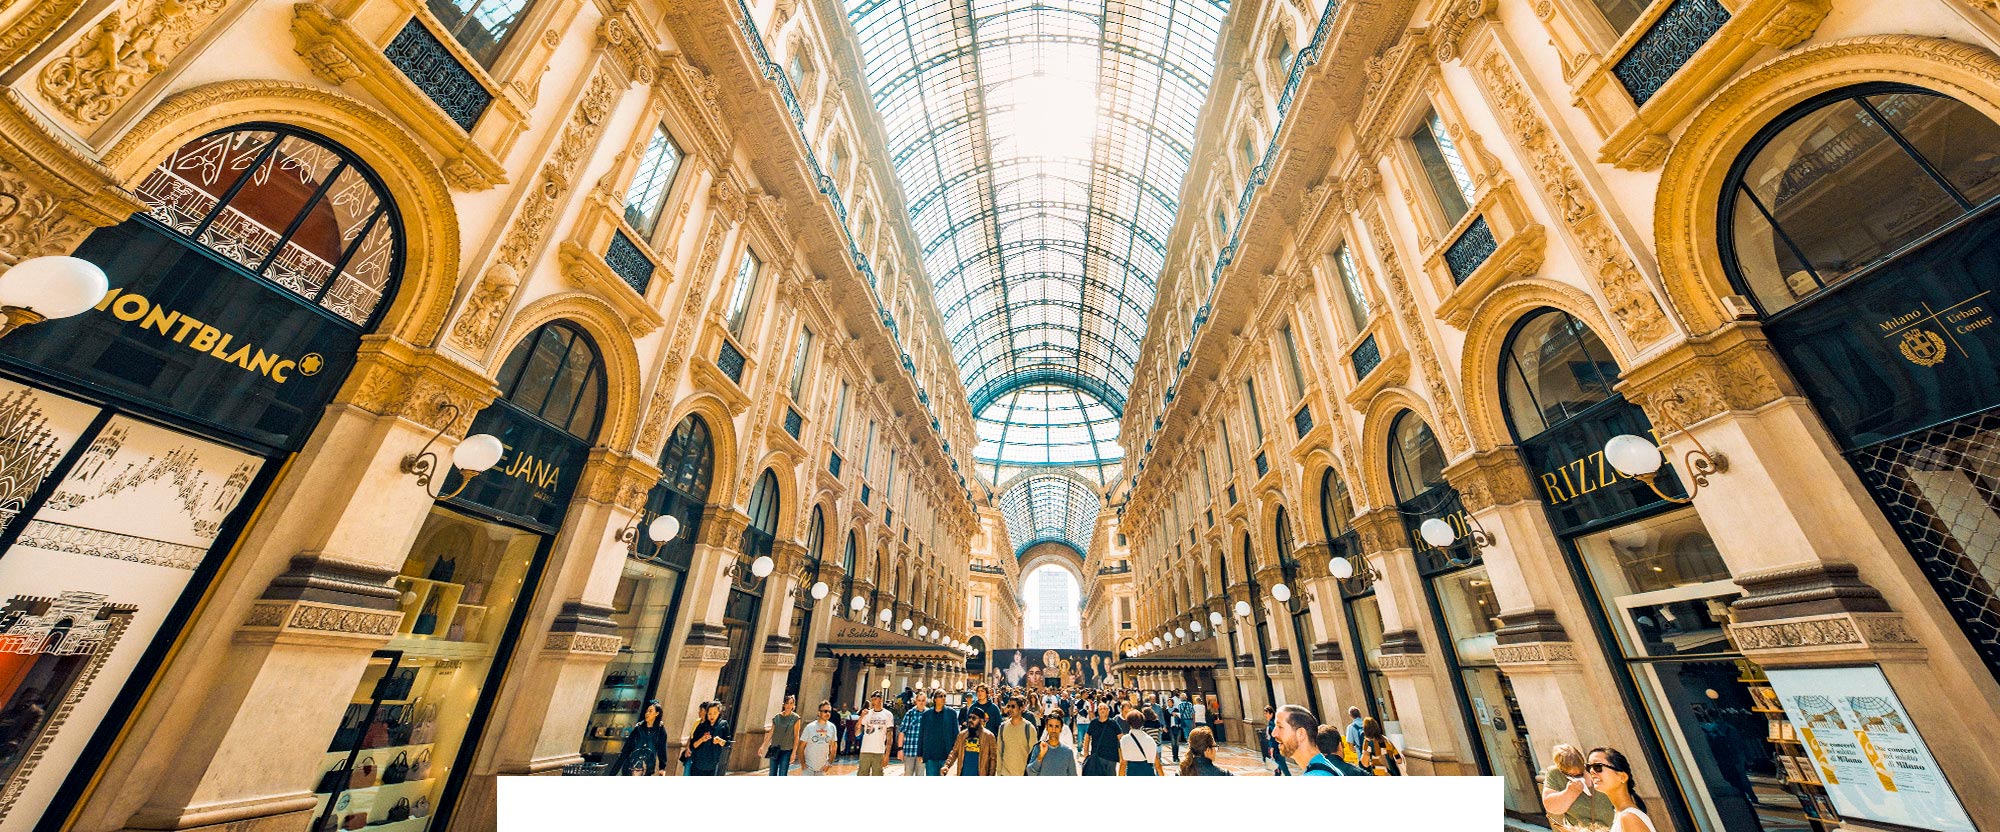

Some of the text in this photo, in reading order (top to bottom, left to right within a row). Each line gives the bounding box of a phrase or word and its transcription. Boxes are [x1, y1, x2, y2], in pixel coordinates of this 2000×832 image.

[1879, 309, 1922, 332] Milano
[1946, 306, 1983, 324] Urban
[1956, 316, 1994, 335] Center
[491, 442, 560, 493] EJANA
[1540, 428, 1672, 505] RIZZI
[847, 627, 879, 638] Salotto
[1887, 747, 1918, 755] concerti
[1895, 761, 1926, 771] Milano
